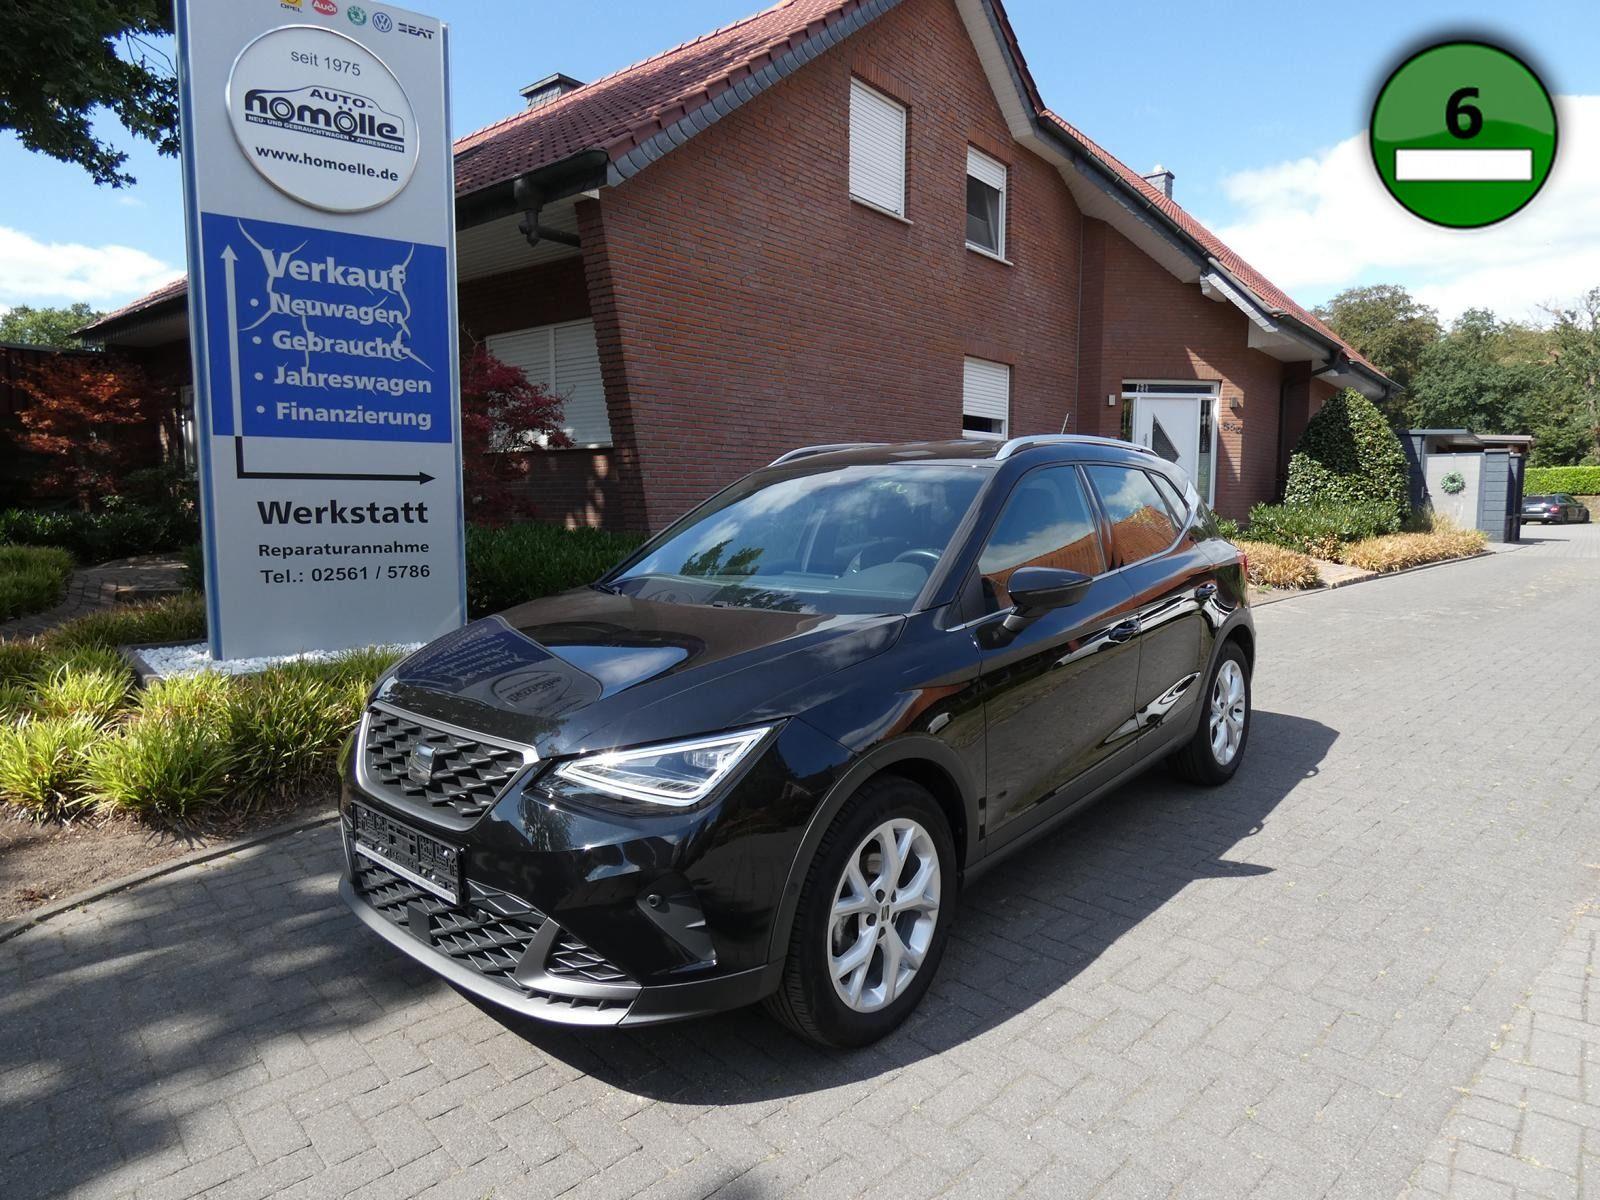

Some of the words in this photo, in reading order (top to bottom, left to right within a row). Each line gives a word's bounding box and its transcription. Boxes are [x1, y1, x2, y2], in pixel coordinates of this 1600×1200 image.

[280, 2, 303, 13] OPEL
[313, 0, 337, 13] Audi
[398, 22, 435, 40] SEAT
[290, 50, 319, 67] seit
[324, 57, 361, 76] 1975
[267, 118, 283, 128] UND
[284, 122, 350, 141] GEBRAUCHTWAGEN
[356, 137, 404, 152] JAHRESWAGEN
[255, 146, 399, 182] www.homoelle.de
[262, 248, 406, 292] Verkauf
[270, 292, 404, 326] Neuwagen
[273, 366, 432, 396] Jahreswagen
[276, 402, 432, 430] Finanzierung
[257, 500, 429, 525] Werkstatt
[258, 540, 430, 559] Reparaturannahme
[260, 569, 304, 584] Tel.:
[311, 566, 368, 582] 02561
[387, 564, 431, 579] 5786
